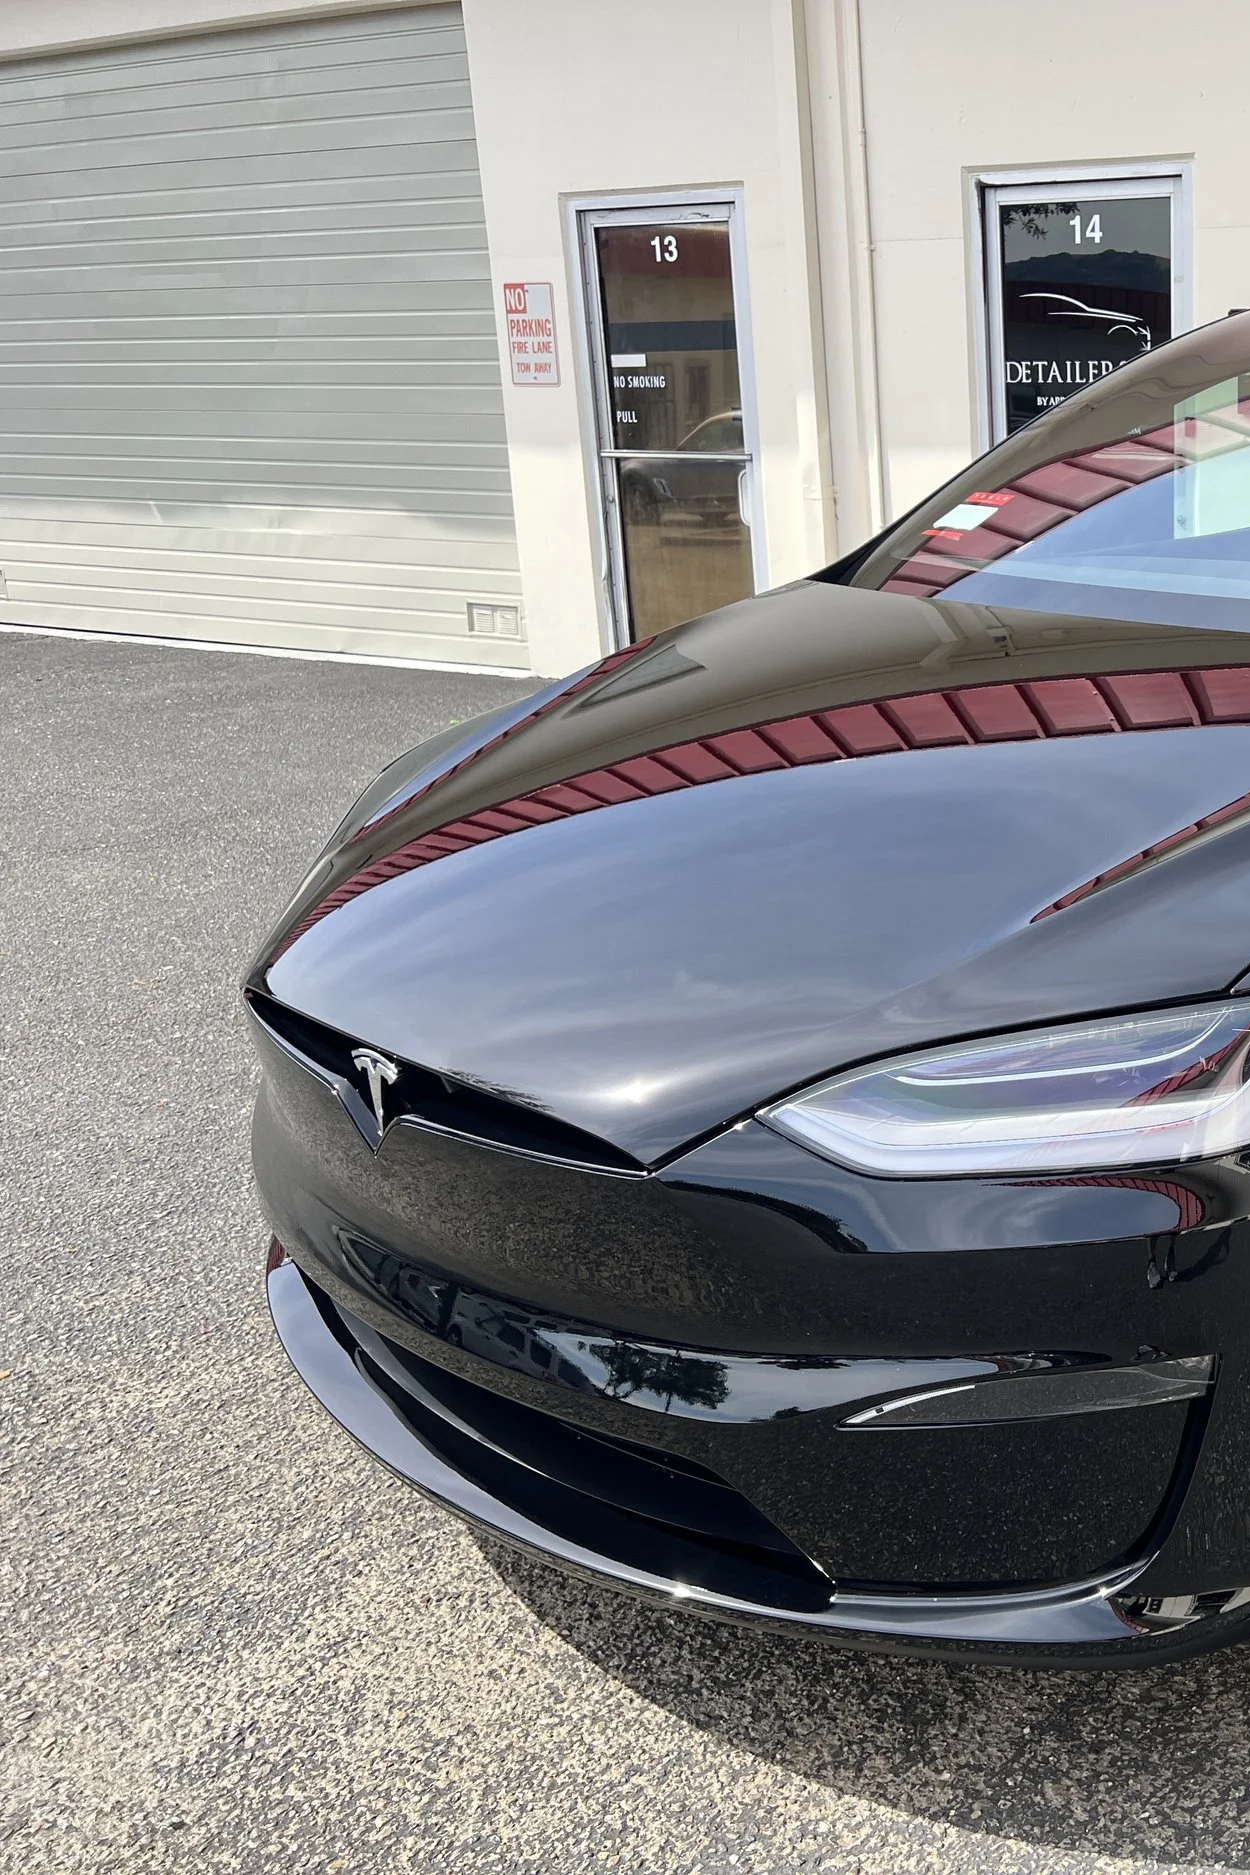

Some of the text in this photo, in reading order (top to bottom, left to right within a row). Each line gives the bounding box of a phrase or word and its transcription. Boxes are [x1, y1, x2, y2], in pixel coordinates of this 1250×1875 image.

[1069, 214, 1103, 244] 14
[650, 236, 679, 262] 13
[505, 288, 525, 311] NO
[509, 318, 553, 338] PARKING
[512, 341, 553, 354] FIRE LANE
[516, 362, 552, 374] TOW AWAY
[1005, 361, 1127, 384] DETAILER
[613, 375, 666, 389] NO SMOKING
[1037, 396, 1049, 406] BY
[616, 411, 638, 424] PULL
